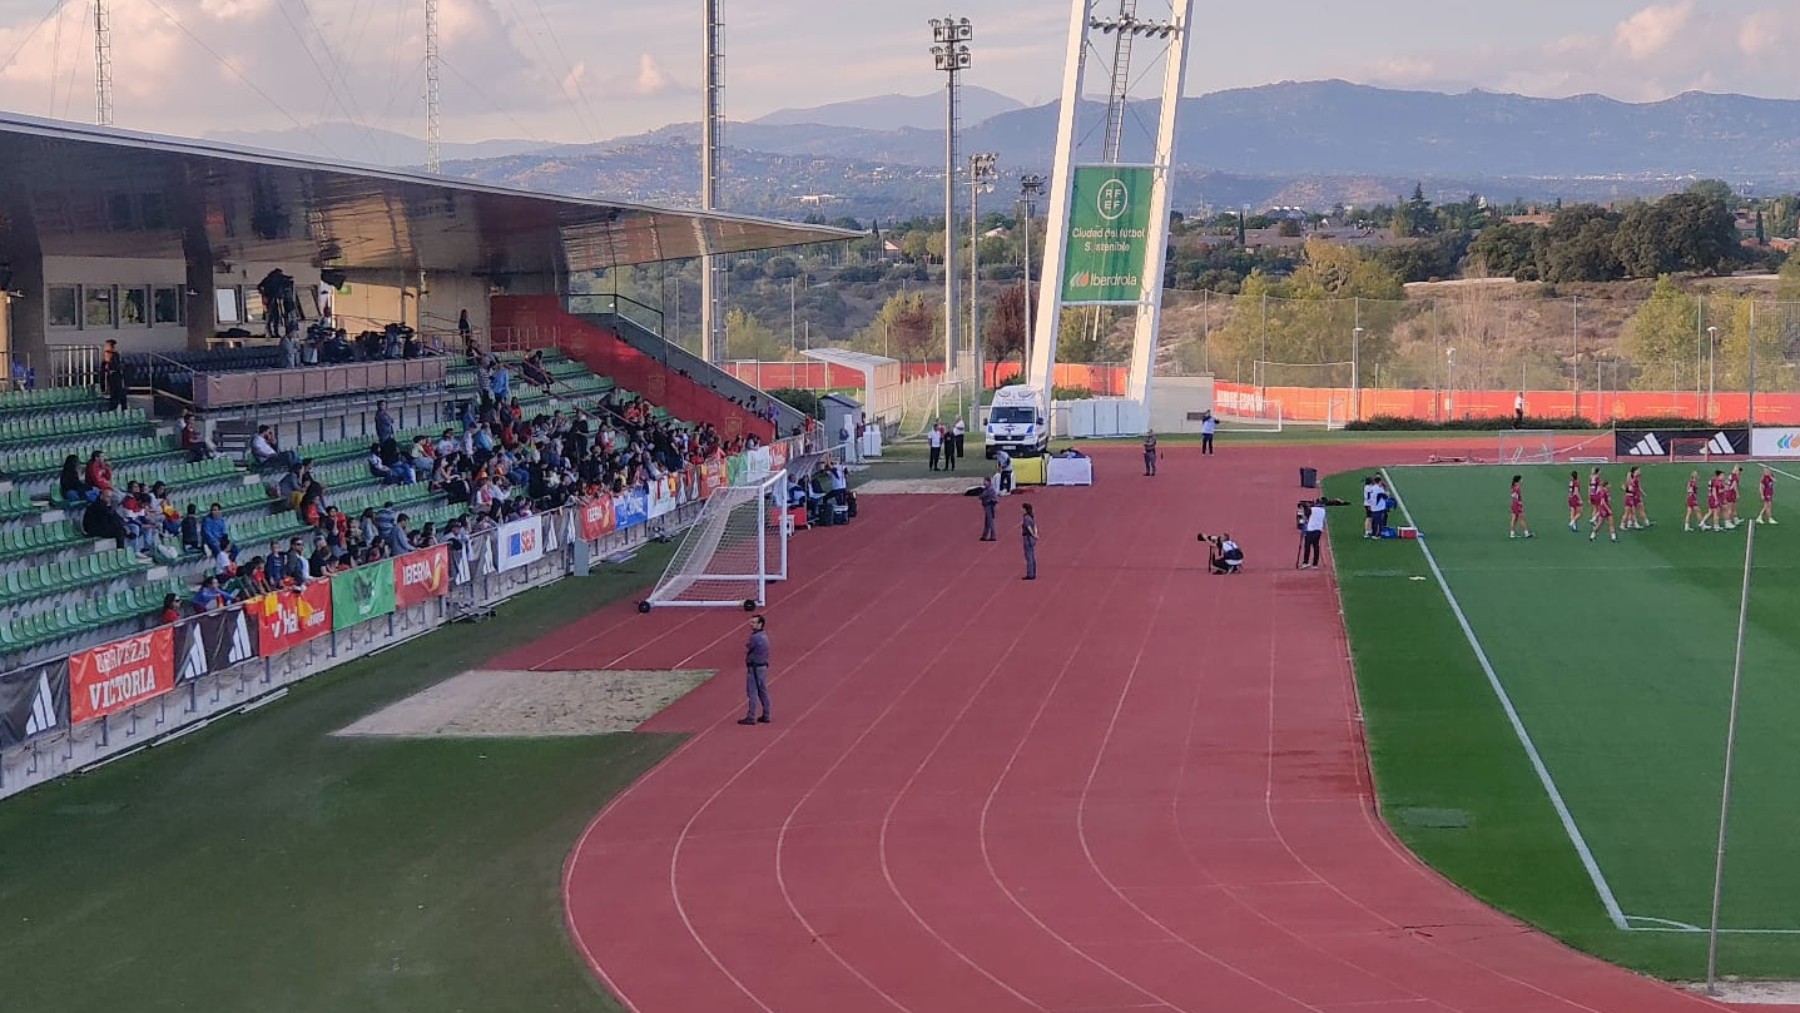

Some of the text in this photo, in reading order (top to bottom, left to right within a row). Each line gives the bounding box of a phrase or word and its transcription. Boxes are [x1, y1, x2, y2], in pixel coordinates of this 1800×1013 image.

[1072, 227, 1104, 238] Ciudad
[1105, 227, 1118, 238] del
[1084, 241, 1131, 252] Sstenible
[1090, 272, 1138, 286] Iberdrola
[402, 559, 433, 586] IBERIA
[95, 640, 151, 674] CERVEZAS
[88, 664, 156, 712] VICTORIA
